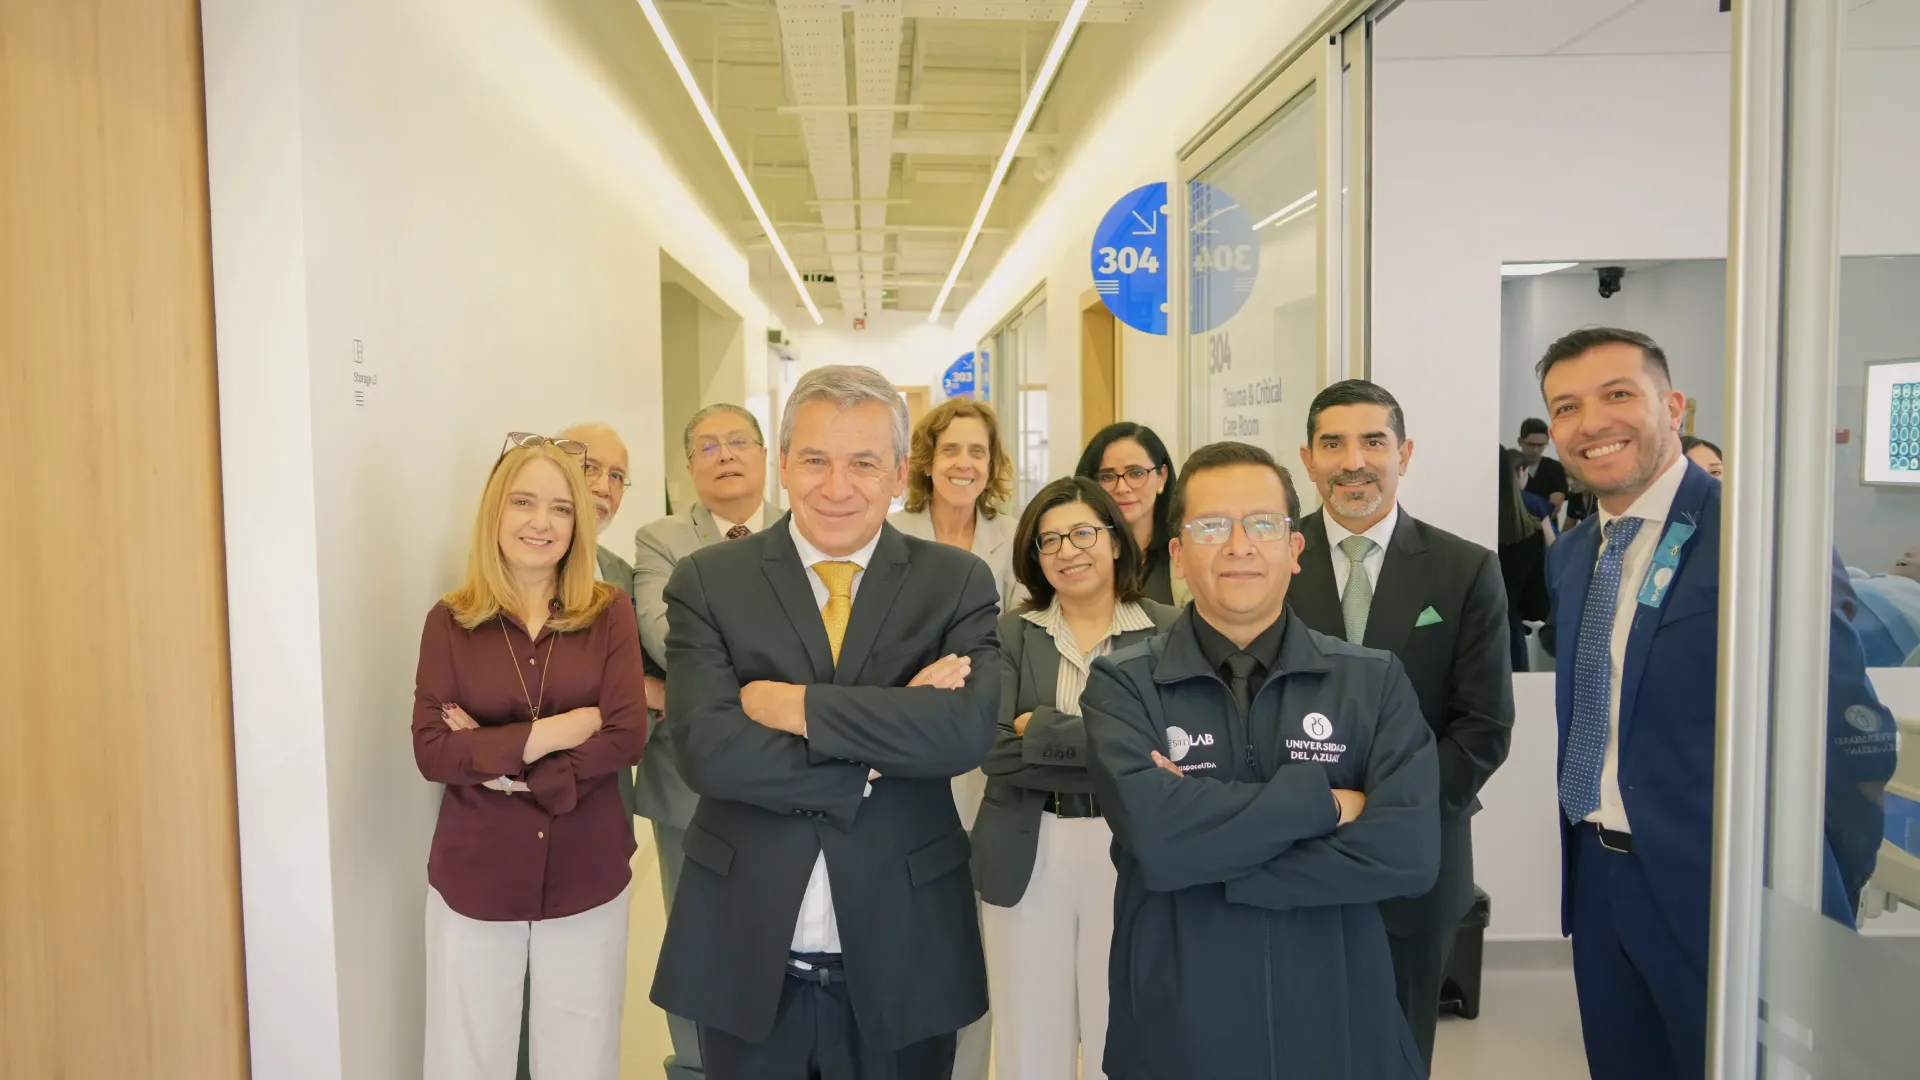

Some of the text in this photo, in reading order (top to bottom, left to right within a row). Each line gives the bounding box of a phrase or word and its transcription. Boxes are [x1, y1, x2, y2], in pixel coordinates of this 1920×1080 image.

[1098, 246, 1159, 274] 304
[1209, 331, 1231, 375] 304
[1255, 376, 1283, 404] Critical
[1223, 414, 1259, 437] Care Room
[1285, 739, 1347, 753] UNIVERSIDAD
[1290, 750, 1340, 763] DEL AZUAY
